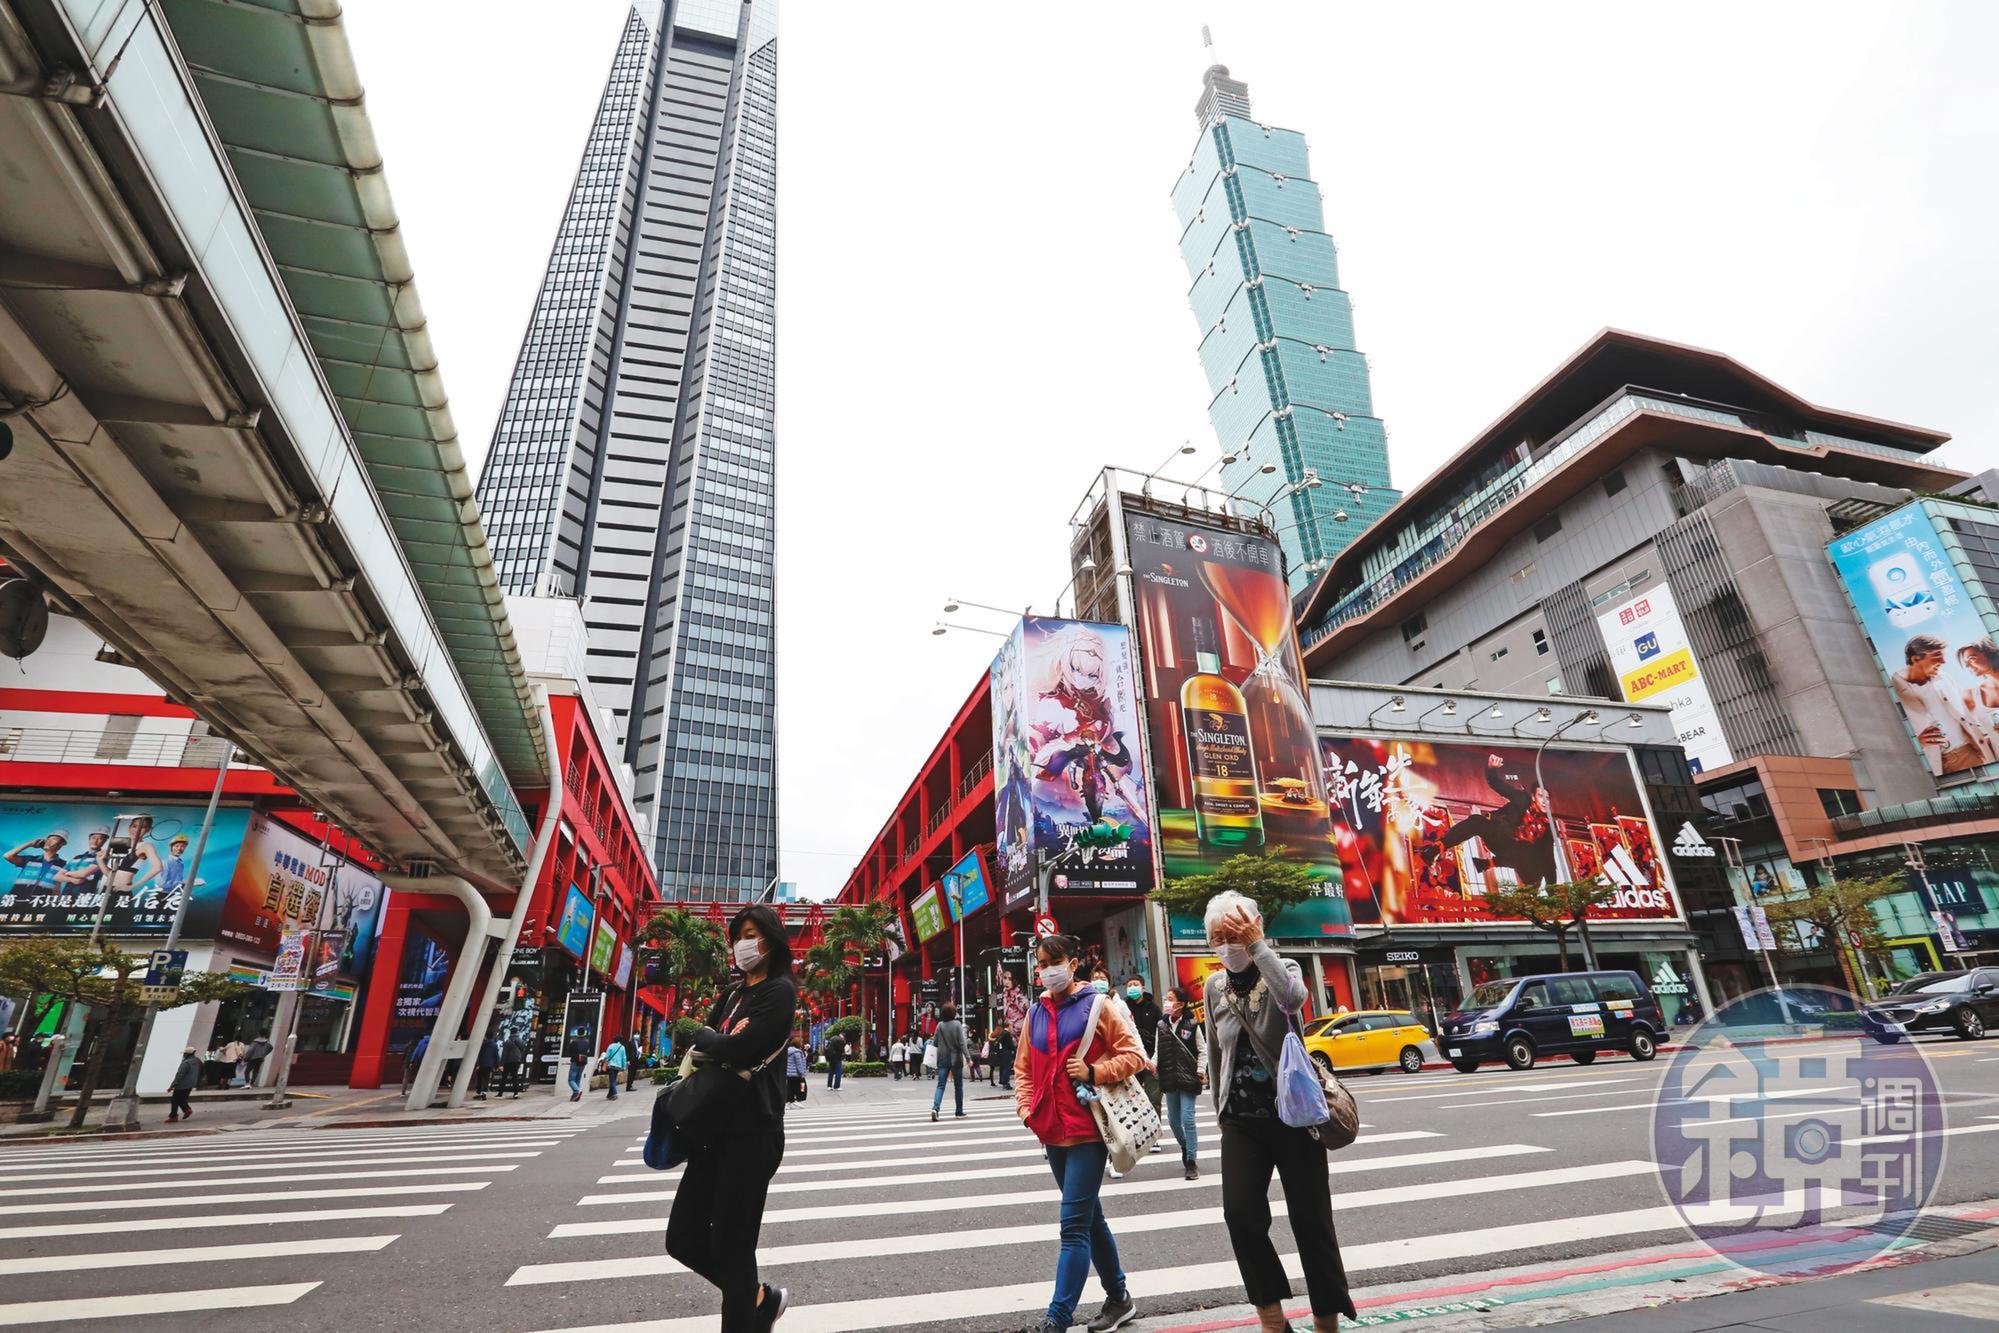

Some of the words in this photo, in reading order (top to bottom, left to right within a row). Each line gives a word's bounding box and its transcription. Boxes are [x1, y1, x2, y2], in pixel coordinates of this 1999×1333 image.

[1133, 521, 1187, 551] 禁止酒駕
[1211, 537, 1270, 567] 酒後不開車
[1150, 572, 1189, 588] SINGLETON
[1637, 638, 1658, 654] GU
[1630, 660, 1688, 693] ABC-MART
[1197, 728, 1247, 746] SINGLETON
[1204, 752, 1222, 760] GLEN
[1224, 753, 1239, 761] ORD
[1216, 764, 1229, 777] 18
[1672, 843, 1716, 857] adidas
[1931, 881, 1967, 904] GAP
[150, 952, 172, 971] P
[1386, 951, 1419, 962] SEIKO
[1651, 981, 1689, 994] adidas
